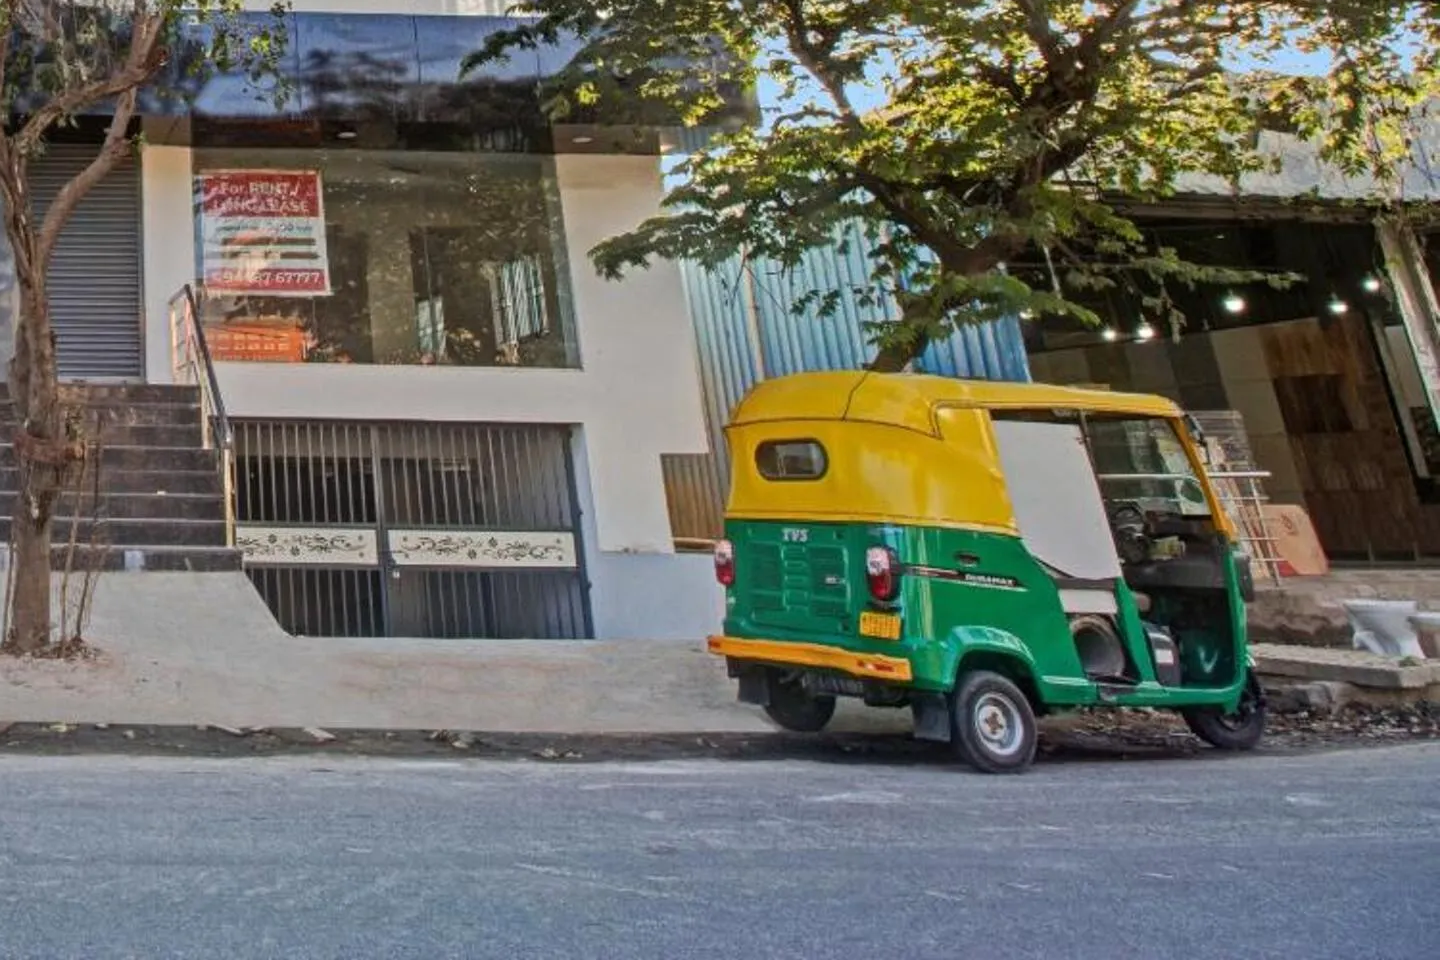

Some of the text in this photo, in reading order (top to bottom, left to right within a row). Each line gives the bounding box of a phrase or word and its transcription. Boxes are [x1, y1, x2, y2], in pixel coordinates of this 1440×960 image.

[219, 181, 246, 195] For
[248, 181, 291, 194] RENT
[781, 527, 809, 543] TVS
